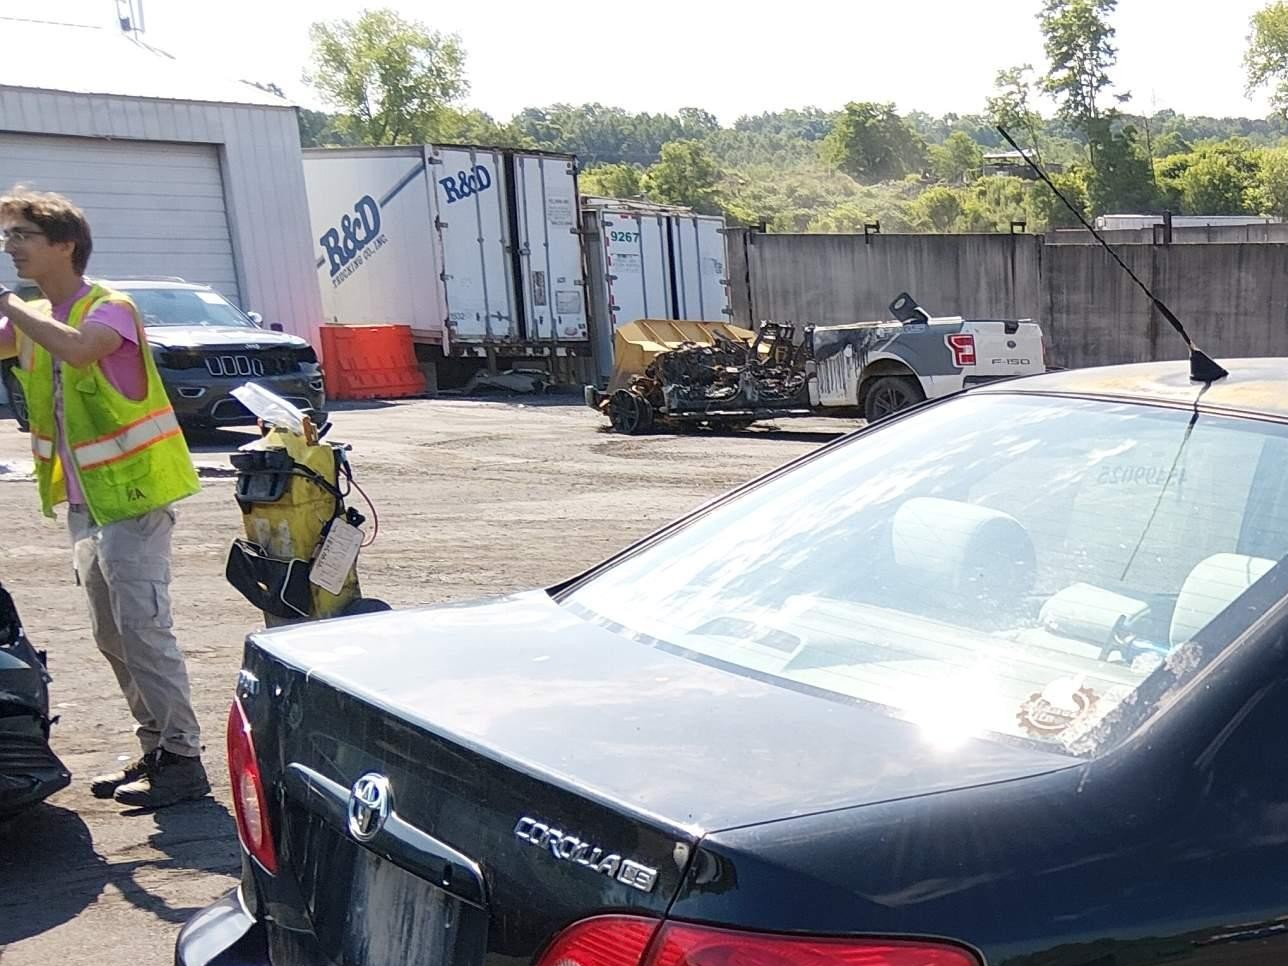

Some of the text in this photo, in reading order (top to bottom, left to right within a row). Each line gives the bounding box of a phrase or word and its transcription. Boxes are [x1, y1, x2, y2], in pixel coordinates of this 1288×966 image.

[439, 165, 491, 203] R&D
[320, 195, 381, 277] R&D
[610, 231, 640, 243] 9267
[991, 358, 1031, 366] F-150
[514, 816, 622, 878] COROLLA
